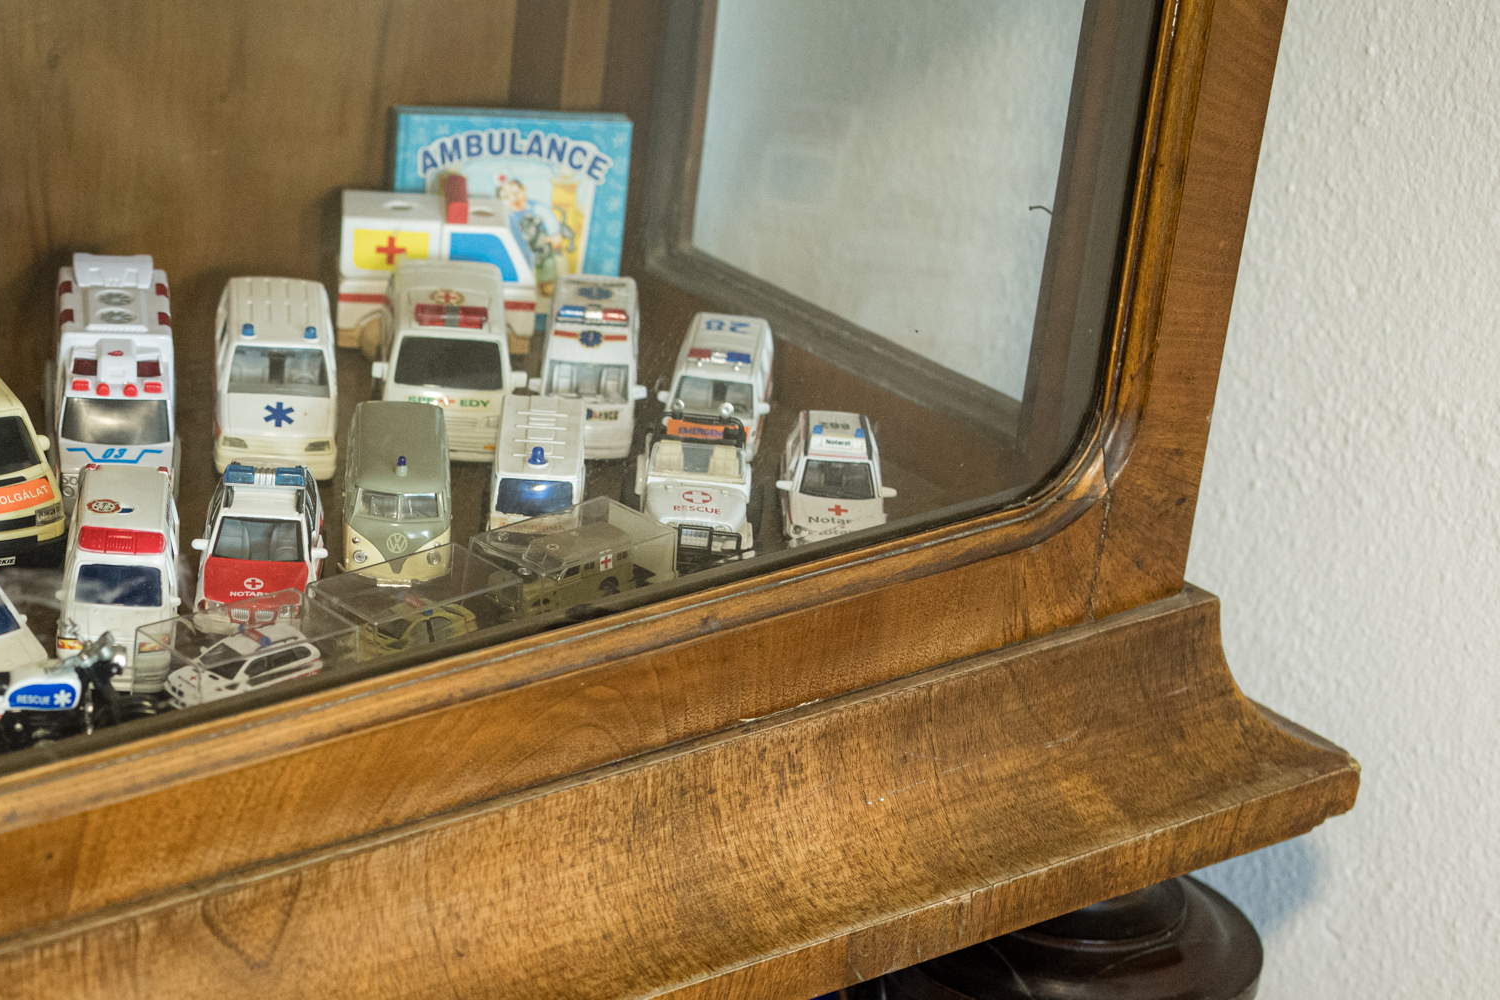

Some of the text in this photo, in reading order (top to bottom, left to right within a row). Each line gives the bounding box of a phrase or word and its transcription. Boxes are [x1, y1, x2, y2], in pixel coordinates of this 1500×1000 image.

[423, 132, 608, 181] AMBULANCE
[678, 426, 724, 438] EMERGEN
[102, 448, 128, 459] 03
[673, 505, 721, 515] RESCUE
[16, 694, 51, 706] RESCUE
